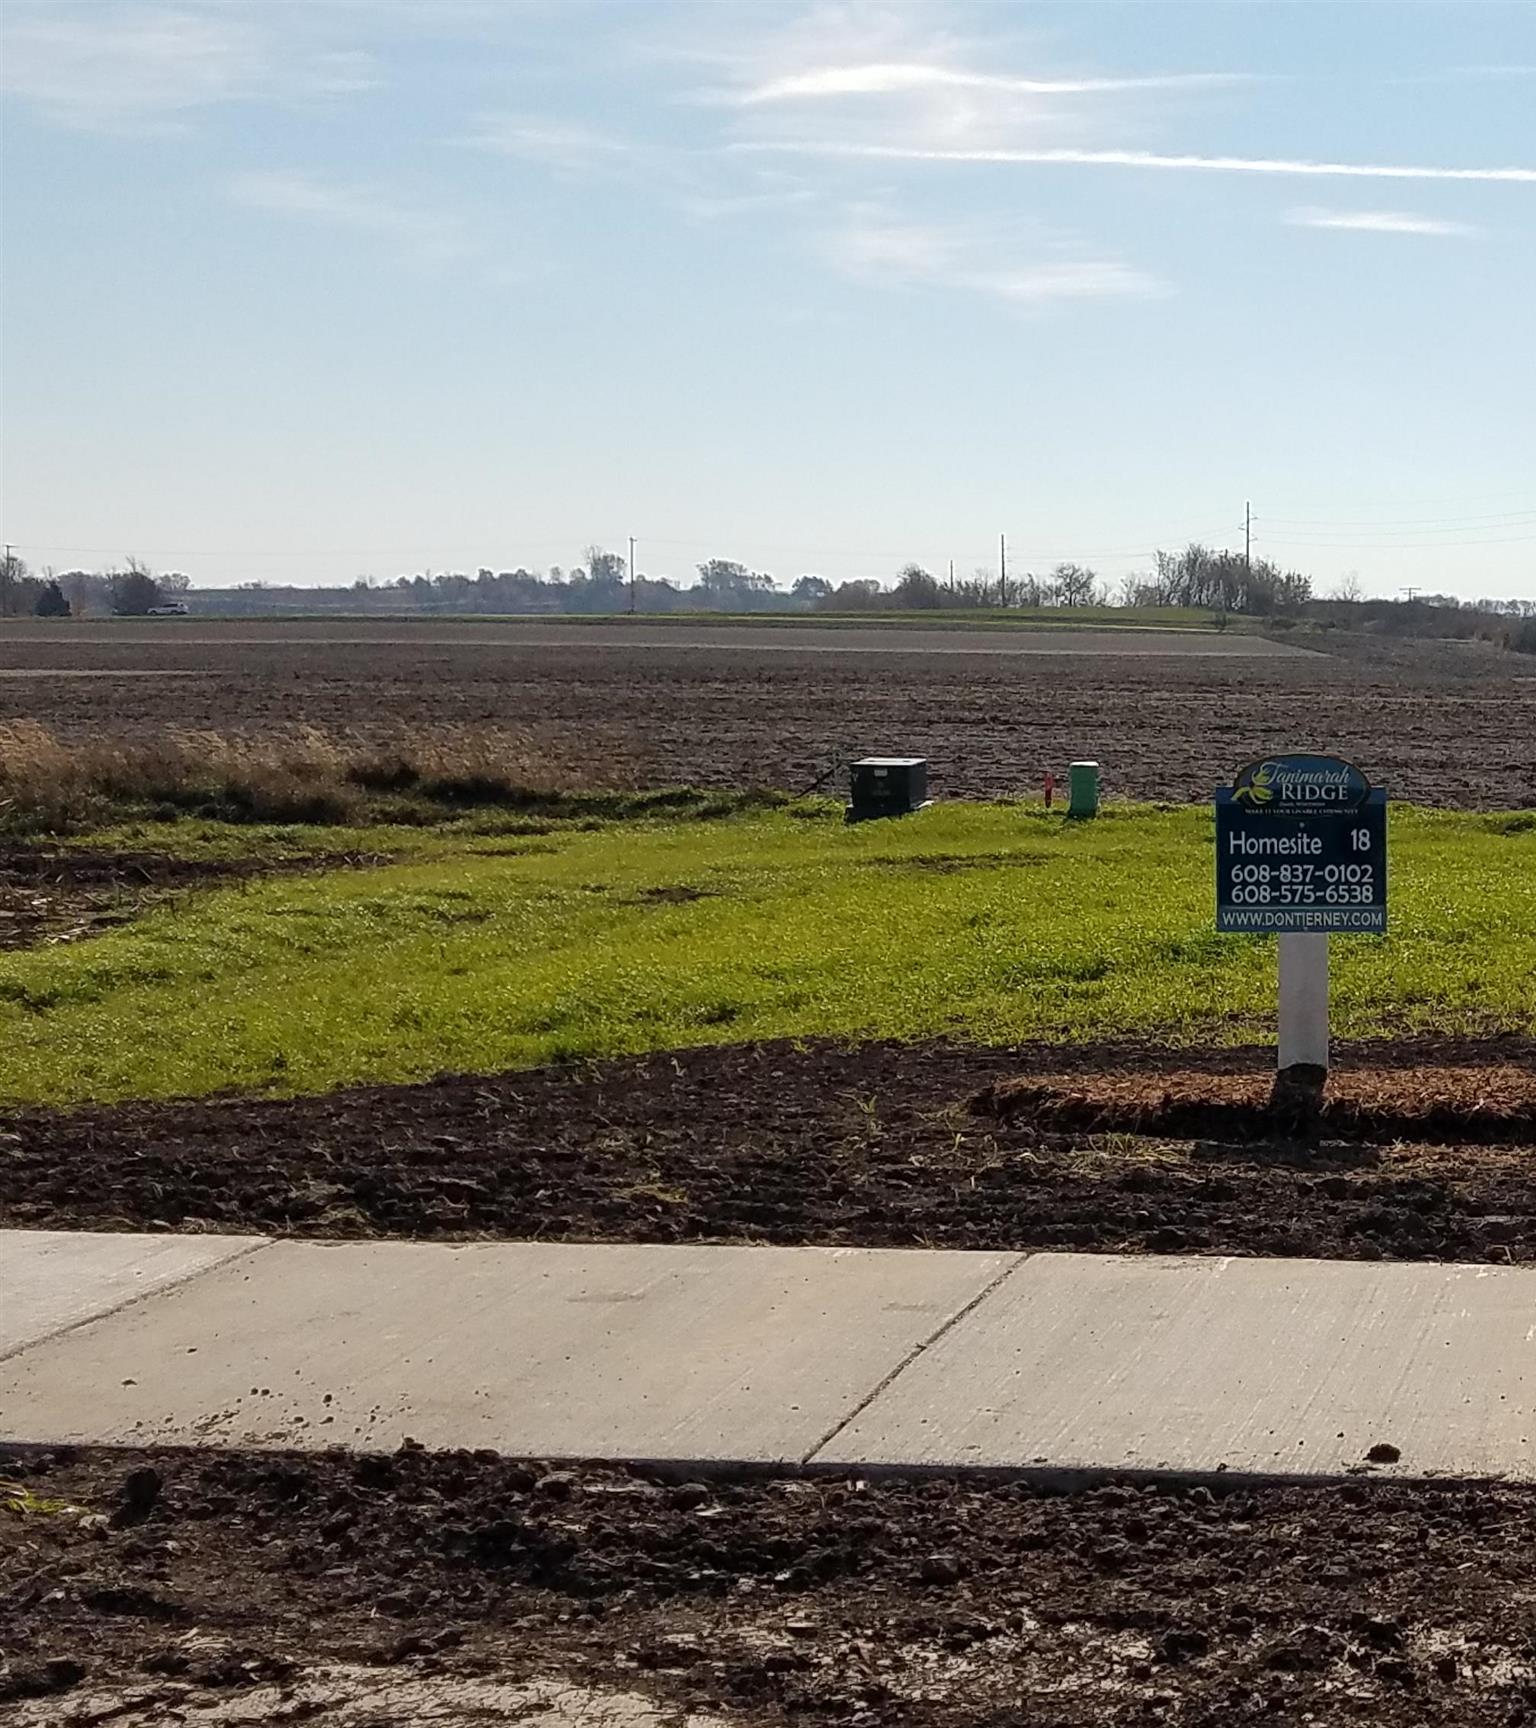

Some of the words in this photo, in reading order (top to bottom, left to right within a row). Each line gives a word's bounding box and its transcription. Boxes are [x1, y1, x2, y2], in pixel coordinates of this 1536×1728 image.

[1252, 761, 1351, 785] Tanimarah
[1281, 785, 1349, 800] RIDGE
[1229, 831, 1323, 855] Homesite
[1350, 828, 1371, 851] 18
[1231, 864, 1374, 883] 608-837-0102
[1231, 885, 1374, 904] 608-575-6538
[1222, 912, 1383, 926] WWW.DONTIERNEY.COM
